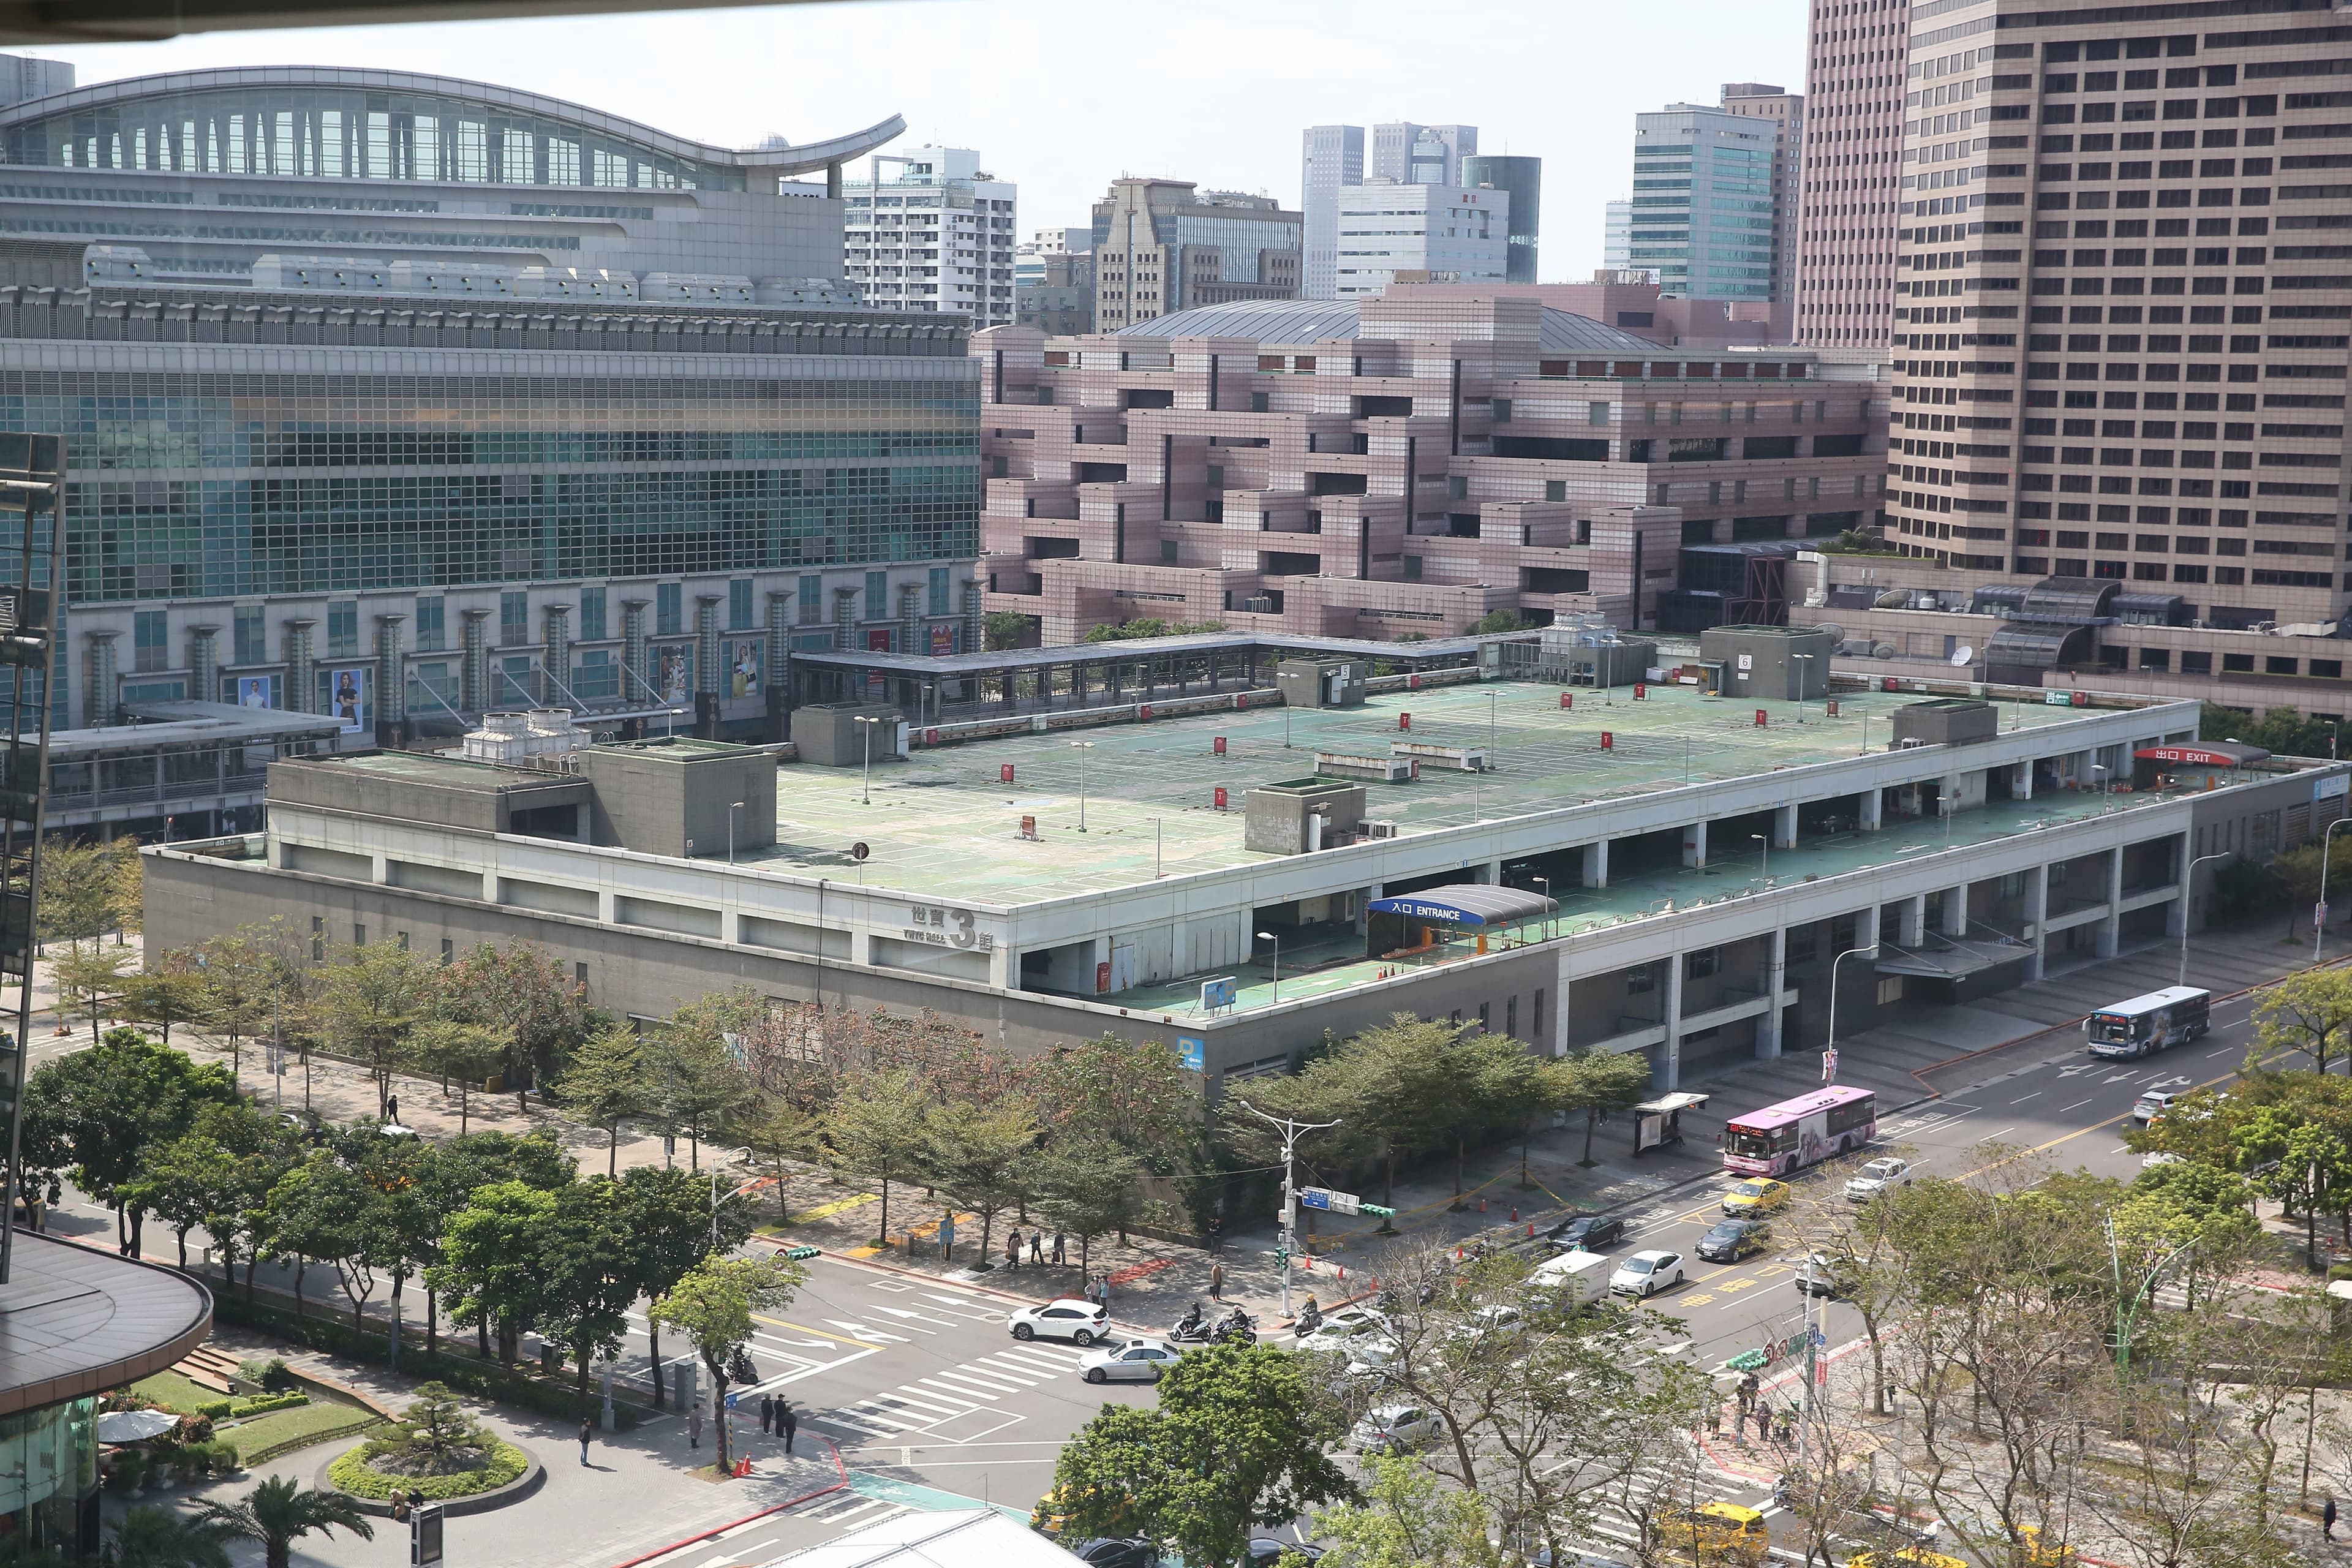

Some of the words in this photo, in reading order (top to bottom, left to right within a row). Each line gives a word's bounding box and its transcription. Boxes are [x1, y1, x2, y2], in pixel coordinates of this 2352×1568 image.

[1742, 657, 1748, 666] 6
[1343, 667, 1348, 677] 5
[2046, 692, 2054, 704] 出口
[2156, 750, 2179, 760] 出口
[2185, 753, 2211, 763] EXIT
[1392, 902, 1412, 914] 入口
[1417, 906, 1460, 921] ENTRANCE
[949, 909, 975, 948] 3
[925, 932, 946, 944] HALL
[1180, 1039, 1194, 1055] P
